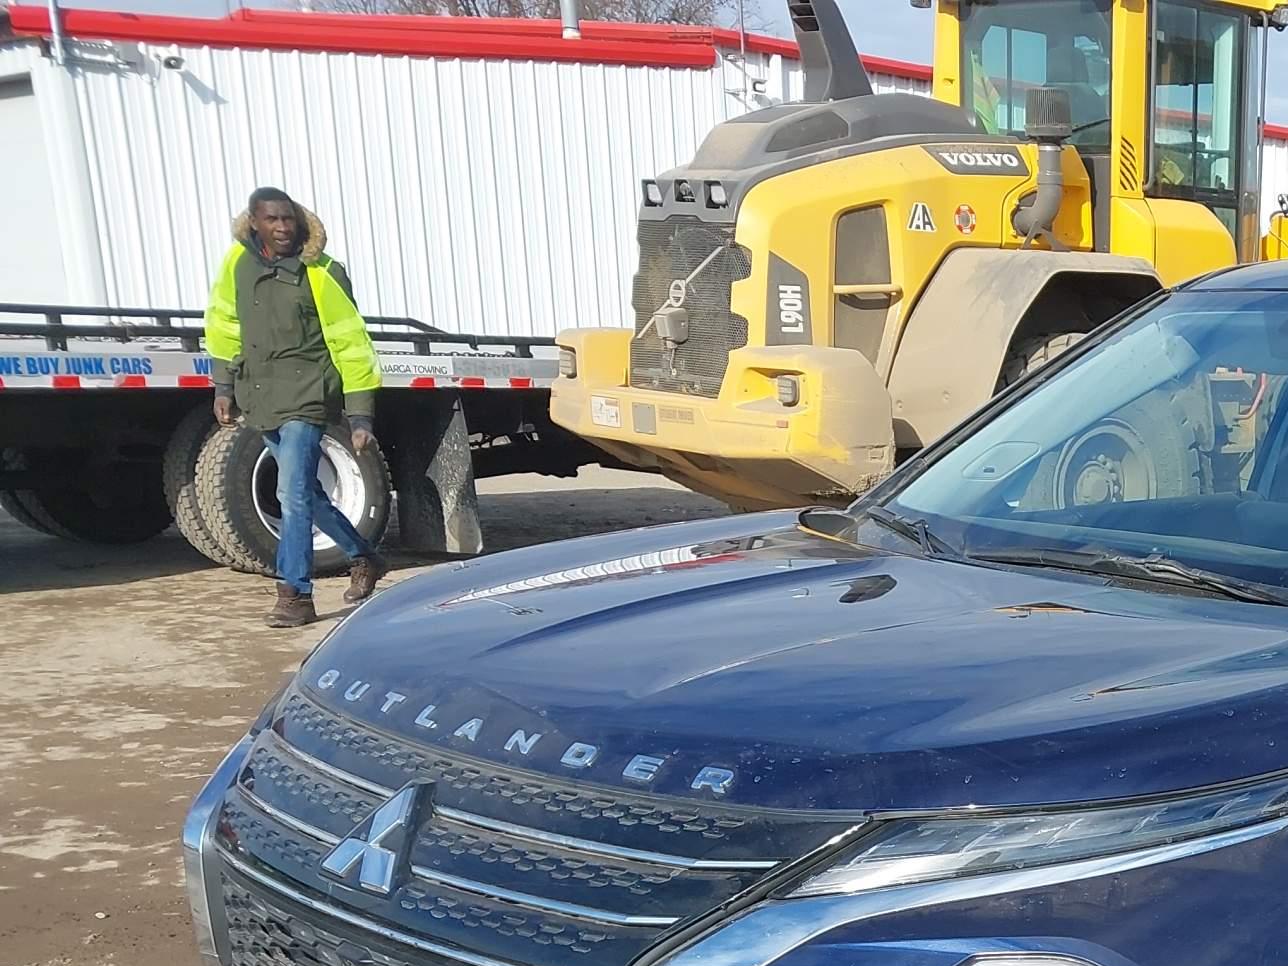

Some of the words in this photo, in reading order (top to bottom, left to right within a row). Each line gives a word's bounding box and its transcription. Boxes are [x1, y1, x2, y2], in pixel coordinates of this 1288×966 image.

[939, 152, 1019, 167] VOLVO
[778, 284, 804, 333] L90H
[25, 356, 60, 375] BUY
[64, 356, 105, 375] JUNK
[110, 356, 153, 375] CARS
[414, 364, 448, 375] TOWING
[317, 668, 736, 796] OUTLANDER
